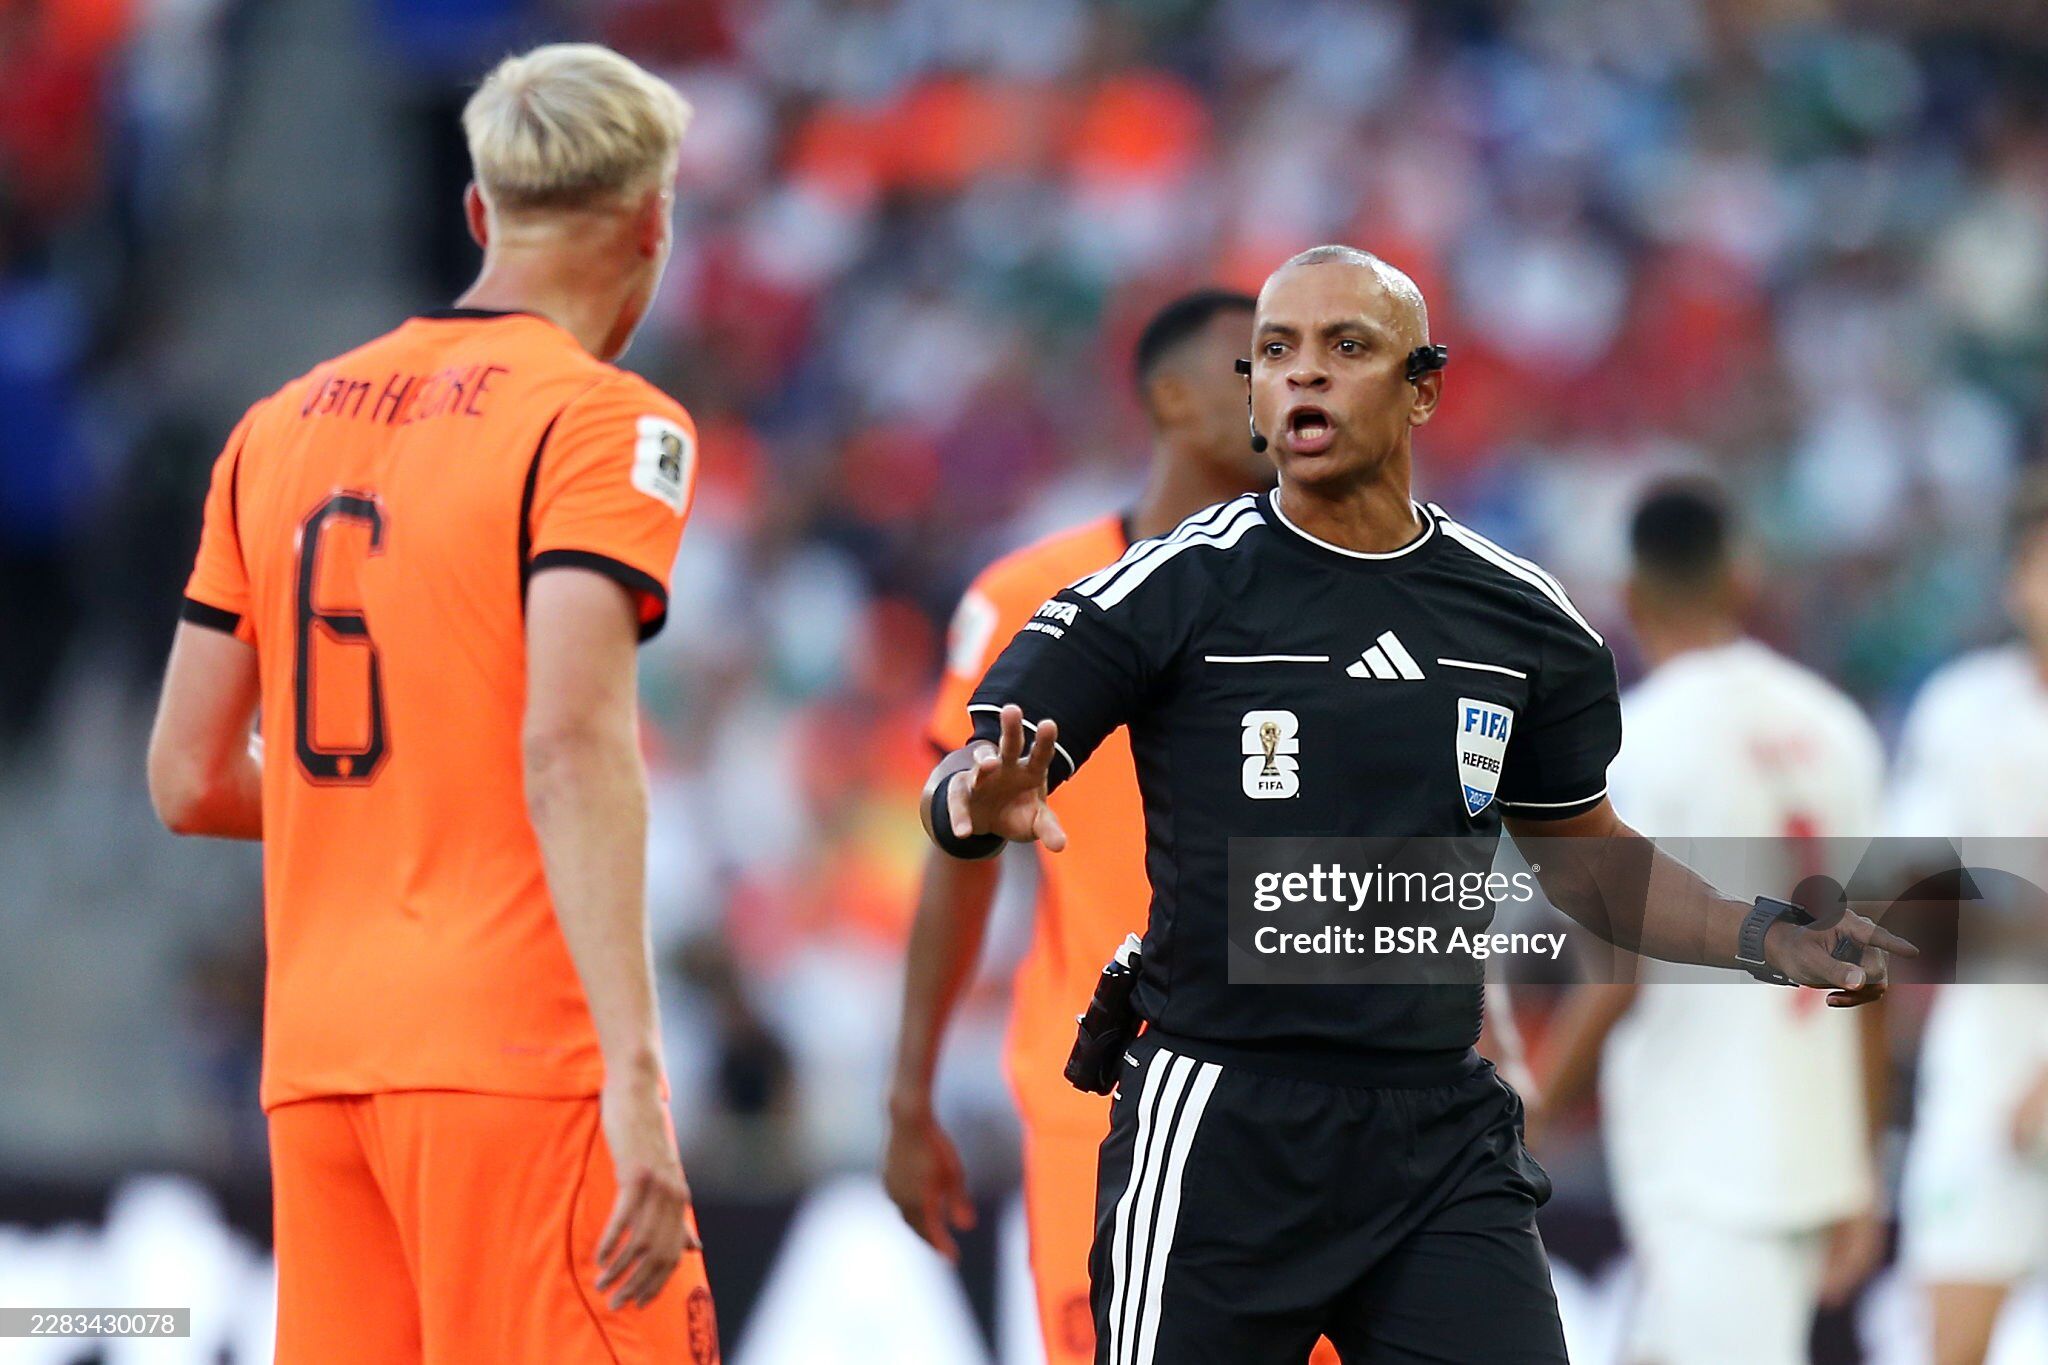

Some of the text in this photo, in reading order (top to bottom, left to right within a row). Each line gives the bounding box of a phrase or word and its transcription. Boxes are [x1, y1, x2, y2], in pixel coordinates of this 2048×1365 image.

[1034, 599, 1079, 627] FIFA
[295, 489, 391, 787] 6
[1464, 707, 1508, 742] FIFA
[1462, 751, 1501, 775] REFEREE
[1258, 781, 1284, 791] FIFA
[1469, 791, 1488, 807] 2026
